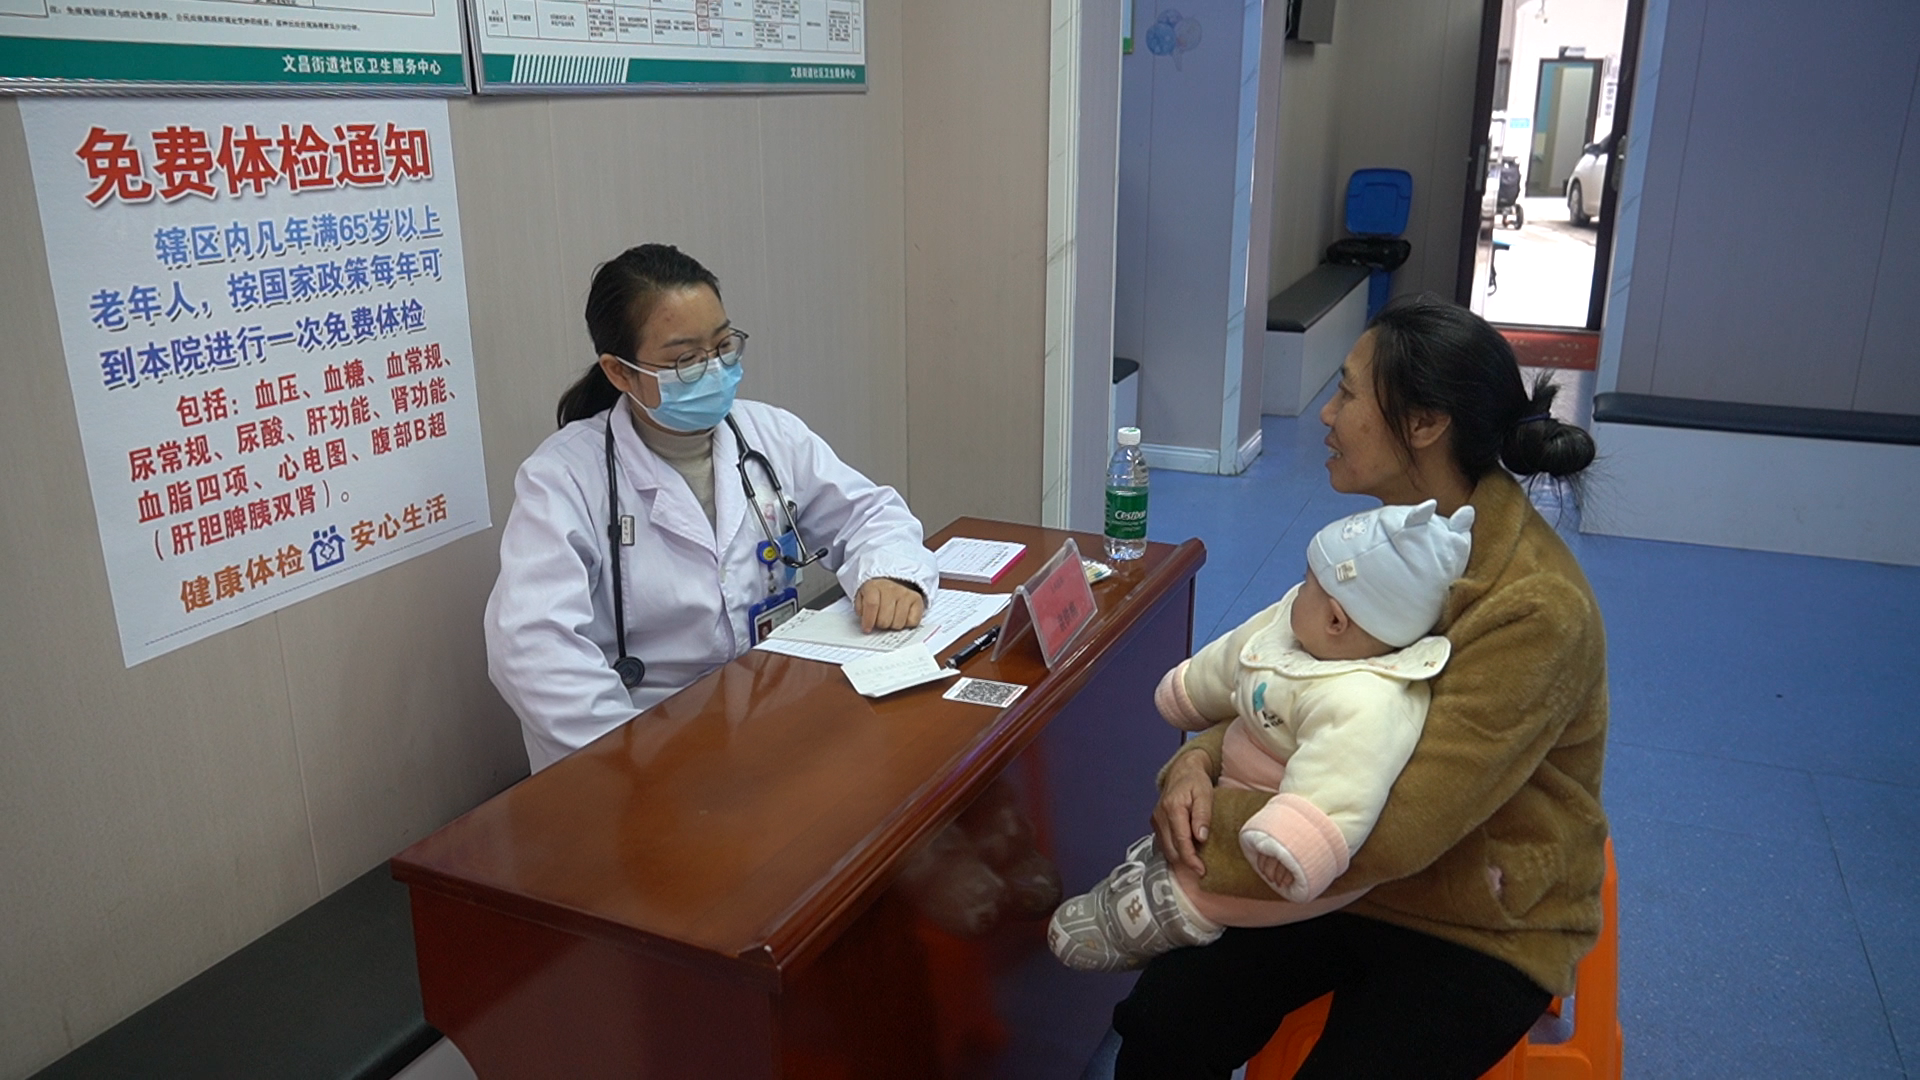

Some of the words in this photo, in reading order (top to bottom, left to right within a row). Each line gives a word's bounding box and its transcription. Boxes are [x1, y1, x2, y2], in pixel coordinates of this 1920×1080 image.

[281, 54, 443, 77] 文昌街道社区卫生服务中心
[76, 122, 433, 205] 免费体检通知
[154, 205, 443, 267] 辖区内凡年满65岁以上
[90, 247, 444, 331] 老年人，按国家政策每年可
[100, 298, 426, 388] 到本院进行一次免费体检
[136, 410, 449, 524] 血脂四项、心电图、腹部B超
[179, 542, 305, 614] 健康体检
[350, 493, 449, 552] 安心生活
